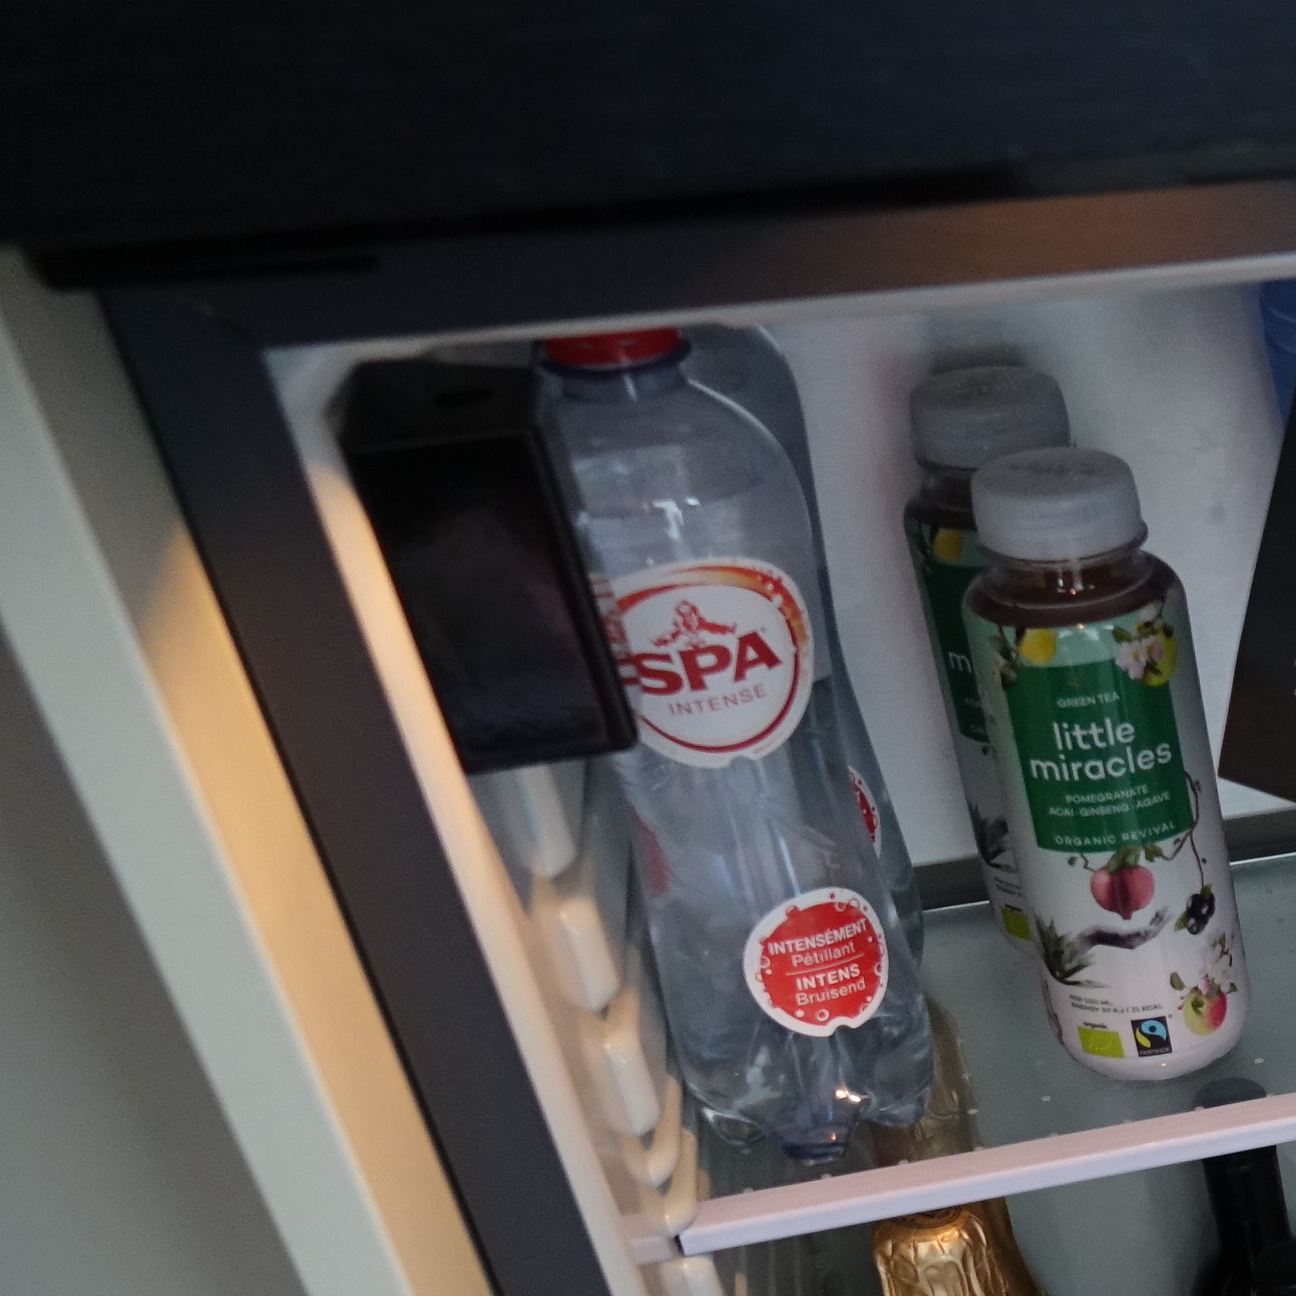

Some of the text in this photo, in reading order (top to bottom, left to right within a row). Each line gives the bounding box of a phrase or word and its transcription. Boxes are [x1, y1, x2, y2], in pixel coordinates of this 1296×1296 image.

[635, 631, 782, 695] SPA
[669, 683, 767, 716] INTENSE
[1056, 691, 1120, 709] GREEN TEA
[1052, 716, 1136, 750] little
[1029, 742, 1173, 782] miracles
[1065, 784, 1149, 804] POMEGRANATE
[1079, 802, 1130, 817] GINSENG
[1136, 791, 1171, 809] AGAVE
[1054, 821, 1176, 848] ORGANIC REVIVAL
[767, 918, 868, 956] INTENSÉMENT
[791, 941, 856, 967] Pétillant
[795, 963, 861, 991] INTENS
[795, 977, 866, 1006] Bruisend
